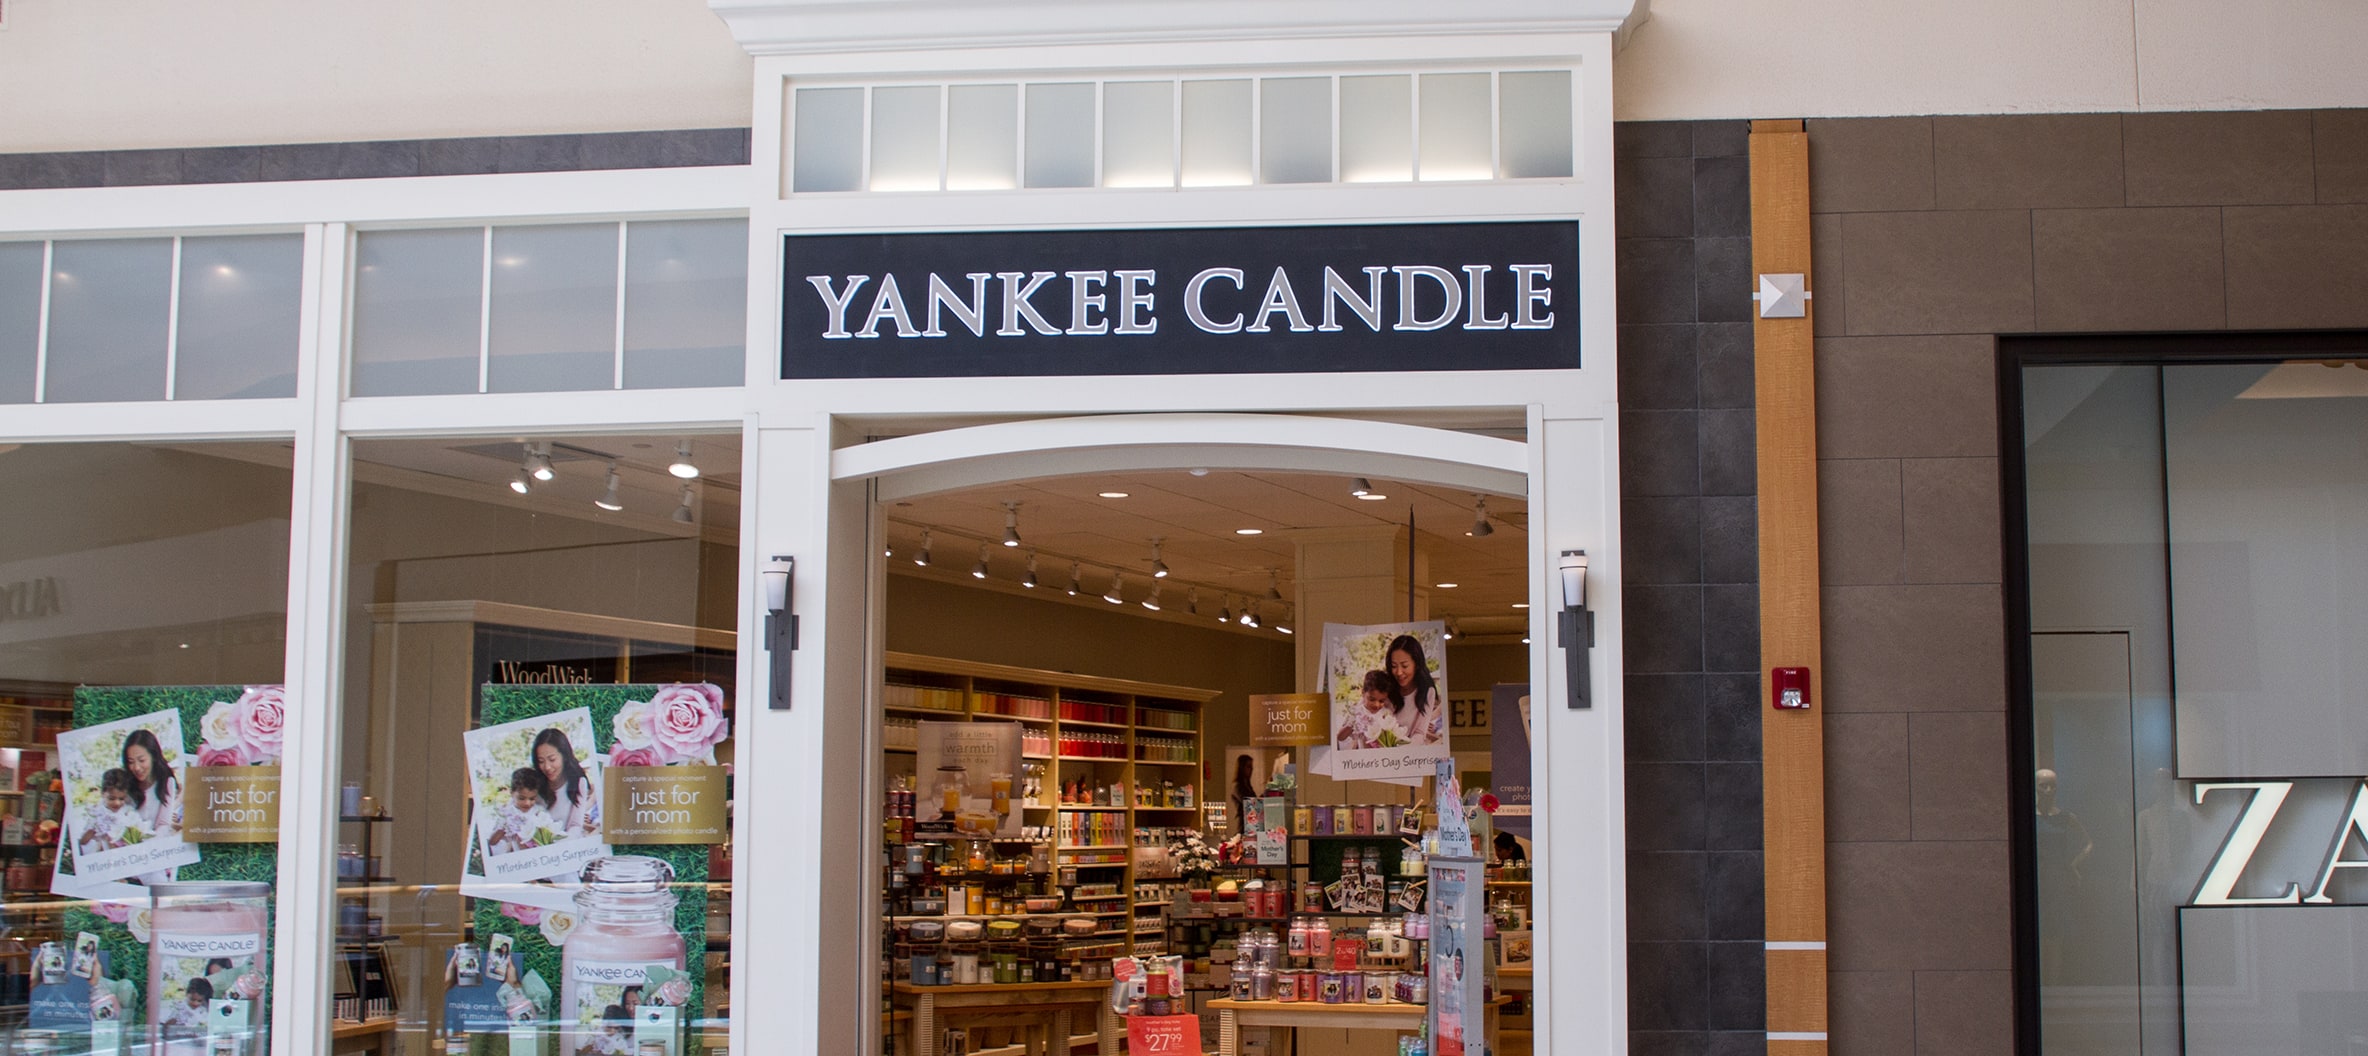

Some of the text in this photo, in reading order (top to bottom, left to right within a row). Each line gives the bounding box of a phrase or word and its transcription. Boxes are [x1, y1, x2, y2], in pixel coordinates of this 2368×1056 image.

[806, 264, 1554, 338] YANKEE CANDLE
[500, 660, 592, 684] WoodWick
[1267, 706, 1312, 724] just for
[1272, 723, 1307, 733] mom
[945, 742, 994, 754] warmth
[1342, 755, 1440, 770] Mother's Day Surprise
[1499, 784, 1525, 792] create
[207, 784, 276, 810] just for
[629, 785, 700, 811] just for
[213, 808, 266, 823] mom
[636, 809, 691, 824] mom
[128, 853, 149, 865] Day
[496, 847, 600, 874] Mother's Day Surprise
[448, 1001, 471, 1011] make
